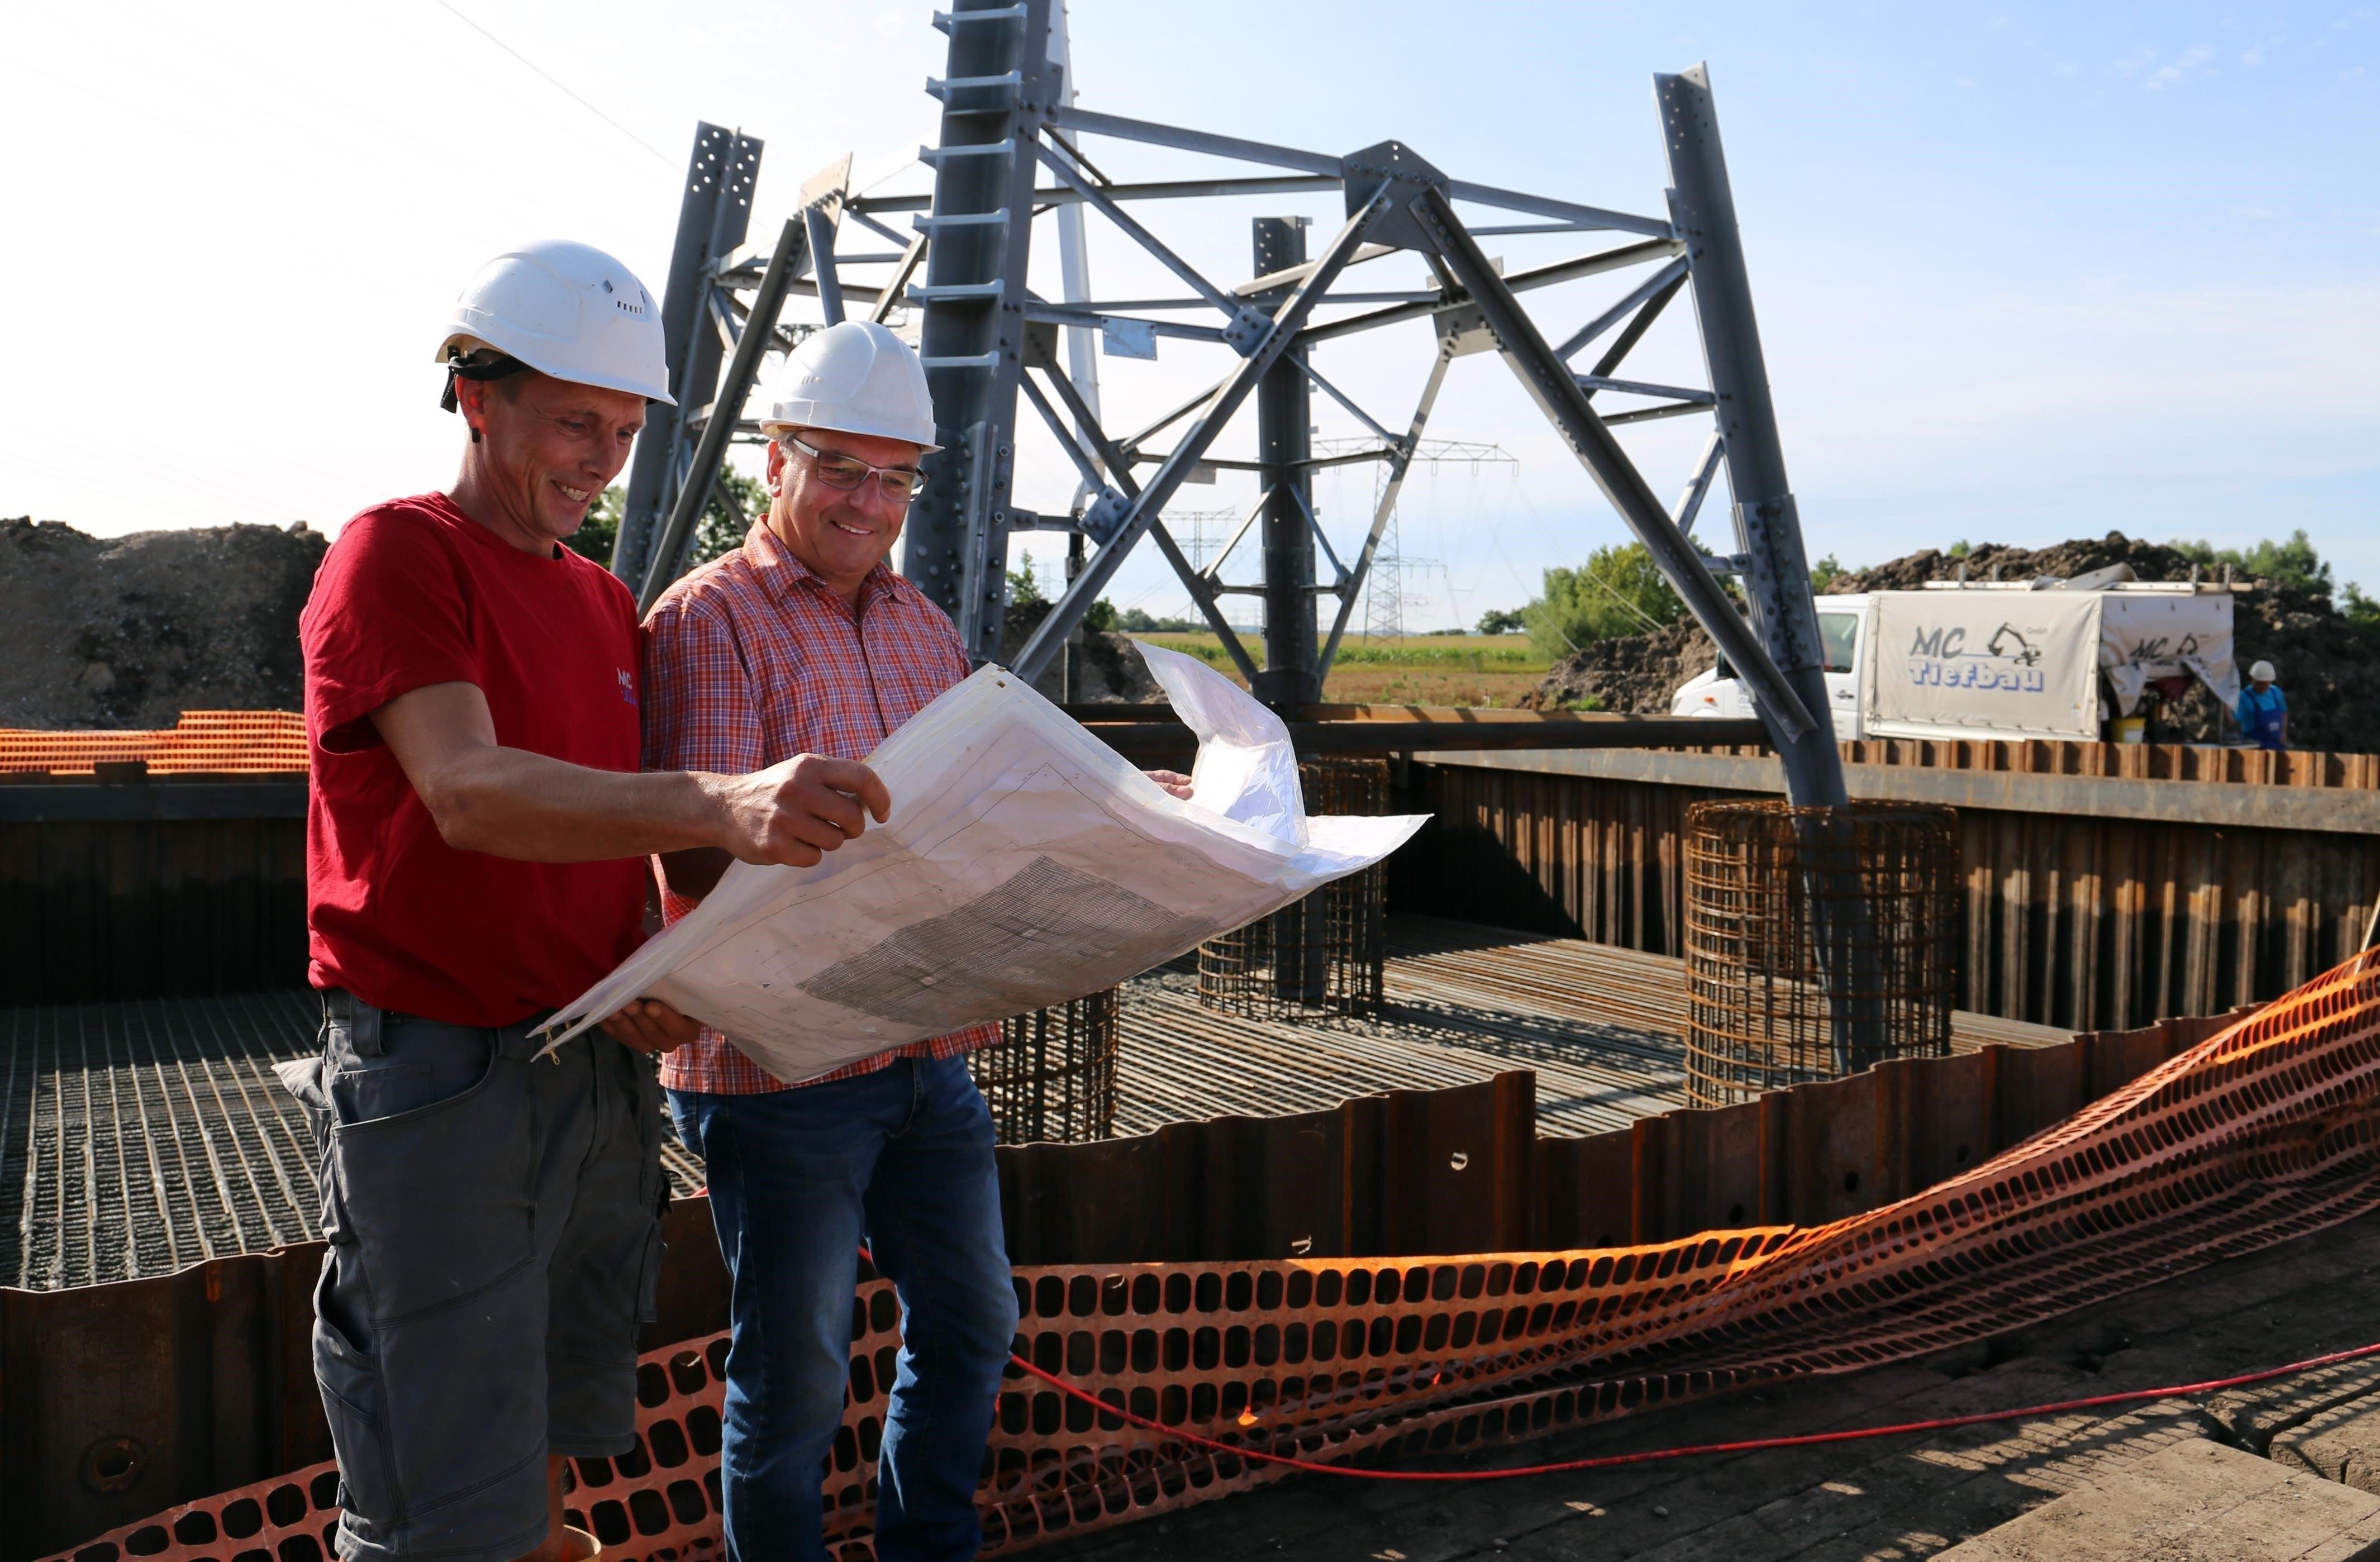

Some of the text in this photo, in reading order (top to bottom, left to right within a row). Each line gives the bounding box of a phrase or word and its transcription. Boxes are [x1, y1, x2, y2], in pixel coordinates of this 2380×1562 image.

[1910, 625, 1966, 659] MC
[2130, 637, 2168, 659] MC
[616, 667, 632, 689] MC
[1908, 658, 2044, 692] Tiefbau
